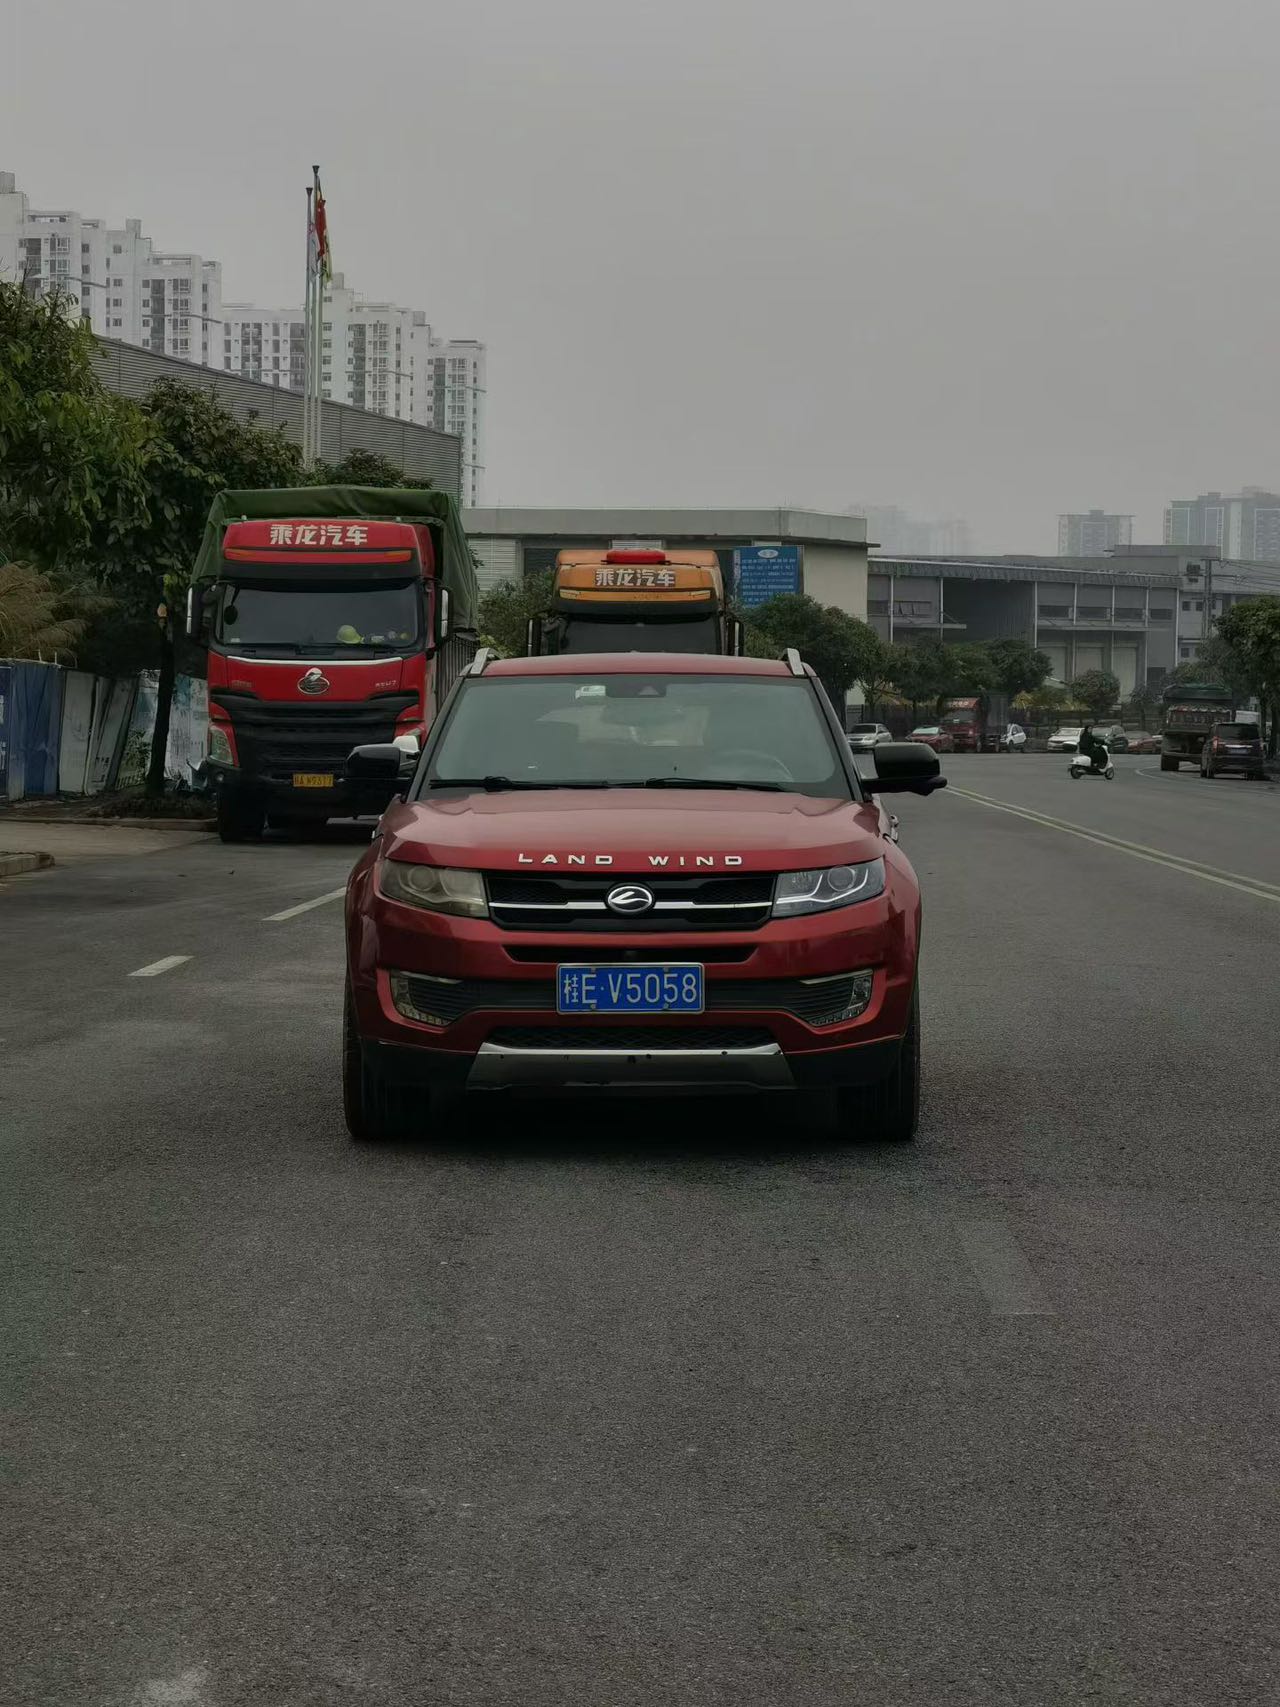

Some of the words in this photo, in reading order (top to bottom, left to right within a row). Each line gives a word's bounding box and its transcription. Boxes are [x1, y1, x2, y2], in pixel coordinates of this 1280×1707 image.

[269, 524, 368, 545] 乘龙汽车
[595, 567, 676, 587] 乘龙汽车
[517, 852, 615, 865] LAND
[648, 855, 743, 866] WIND
